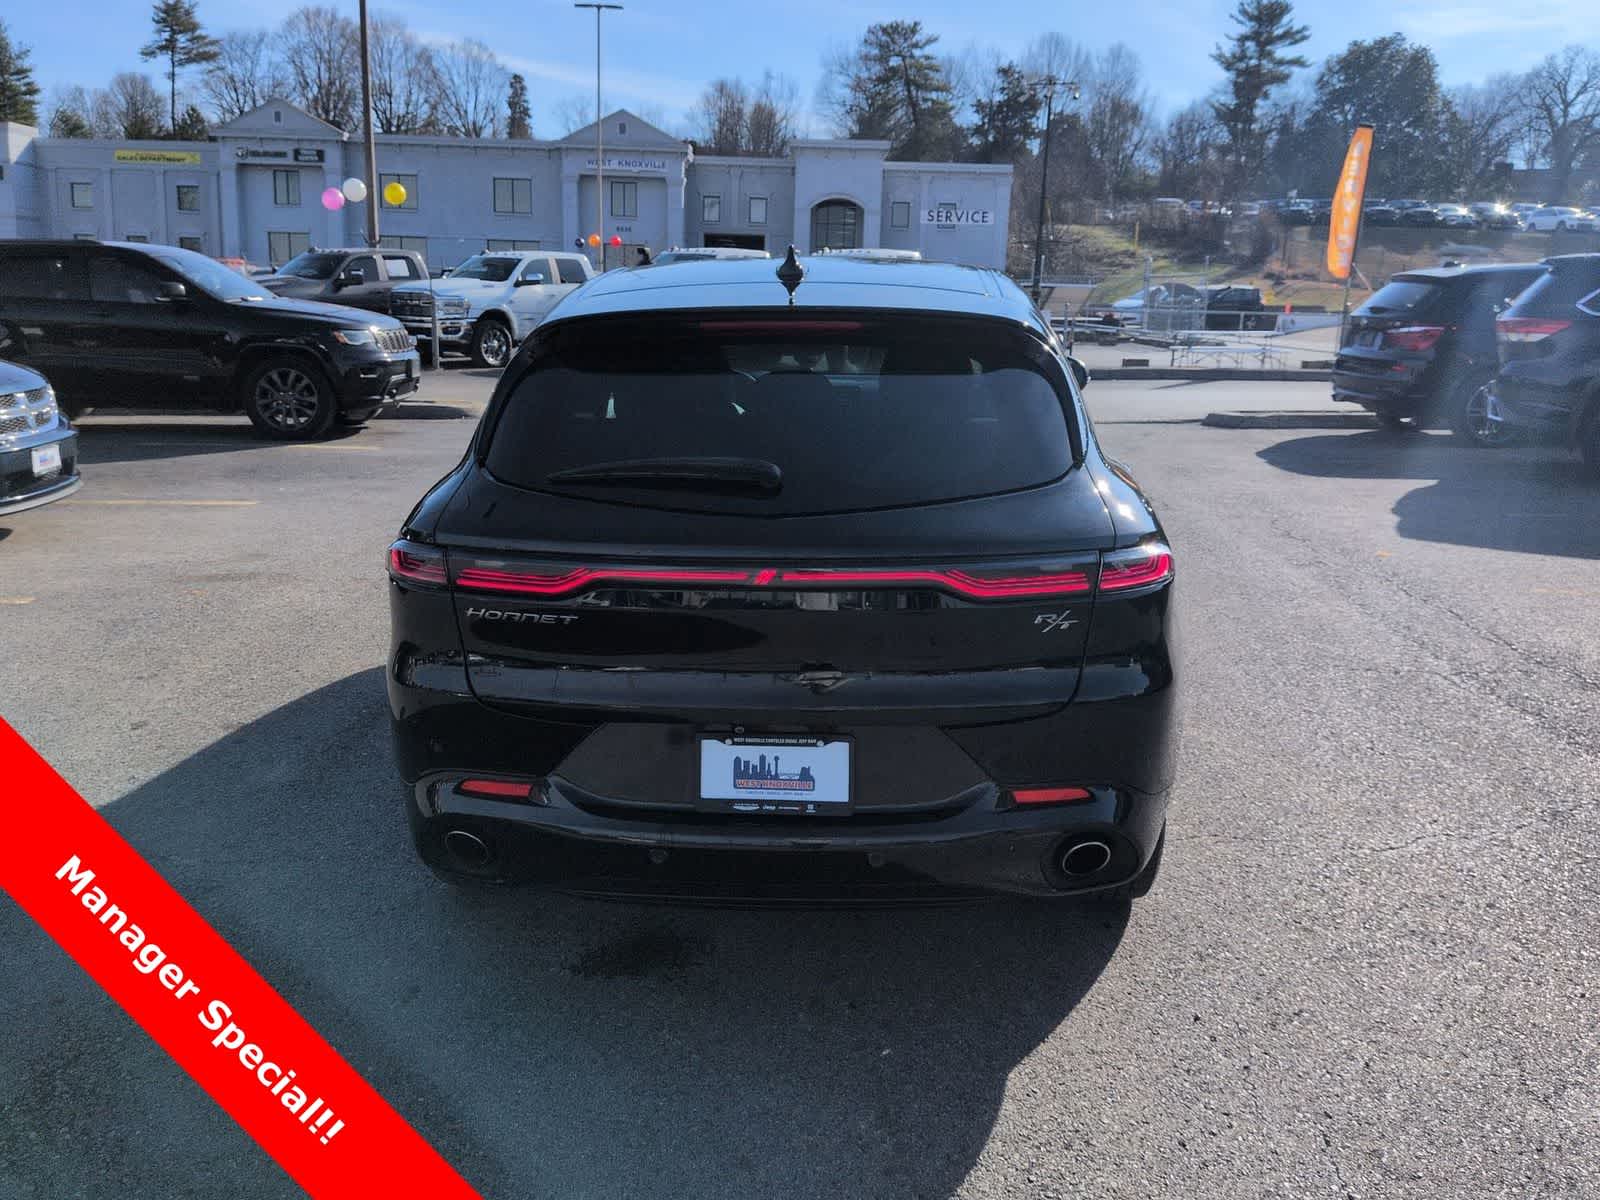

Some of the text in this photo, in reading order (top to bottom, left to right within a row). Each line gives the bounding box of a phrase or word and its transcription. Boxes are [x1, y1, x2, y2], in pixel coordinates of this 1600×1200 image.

[618, 159, 666, 169] KNOXVILLE
[927, 209, 989, 224] SERVICE
[465, 607, 579, 625] HORNET
[1034, 609, 1080, 633] R/T
